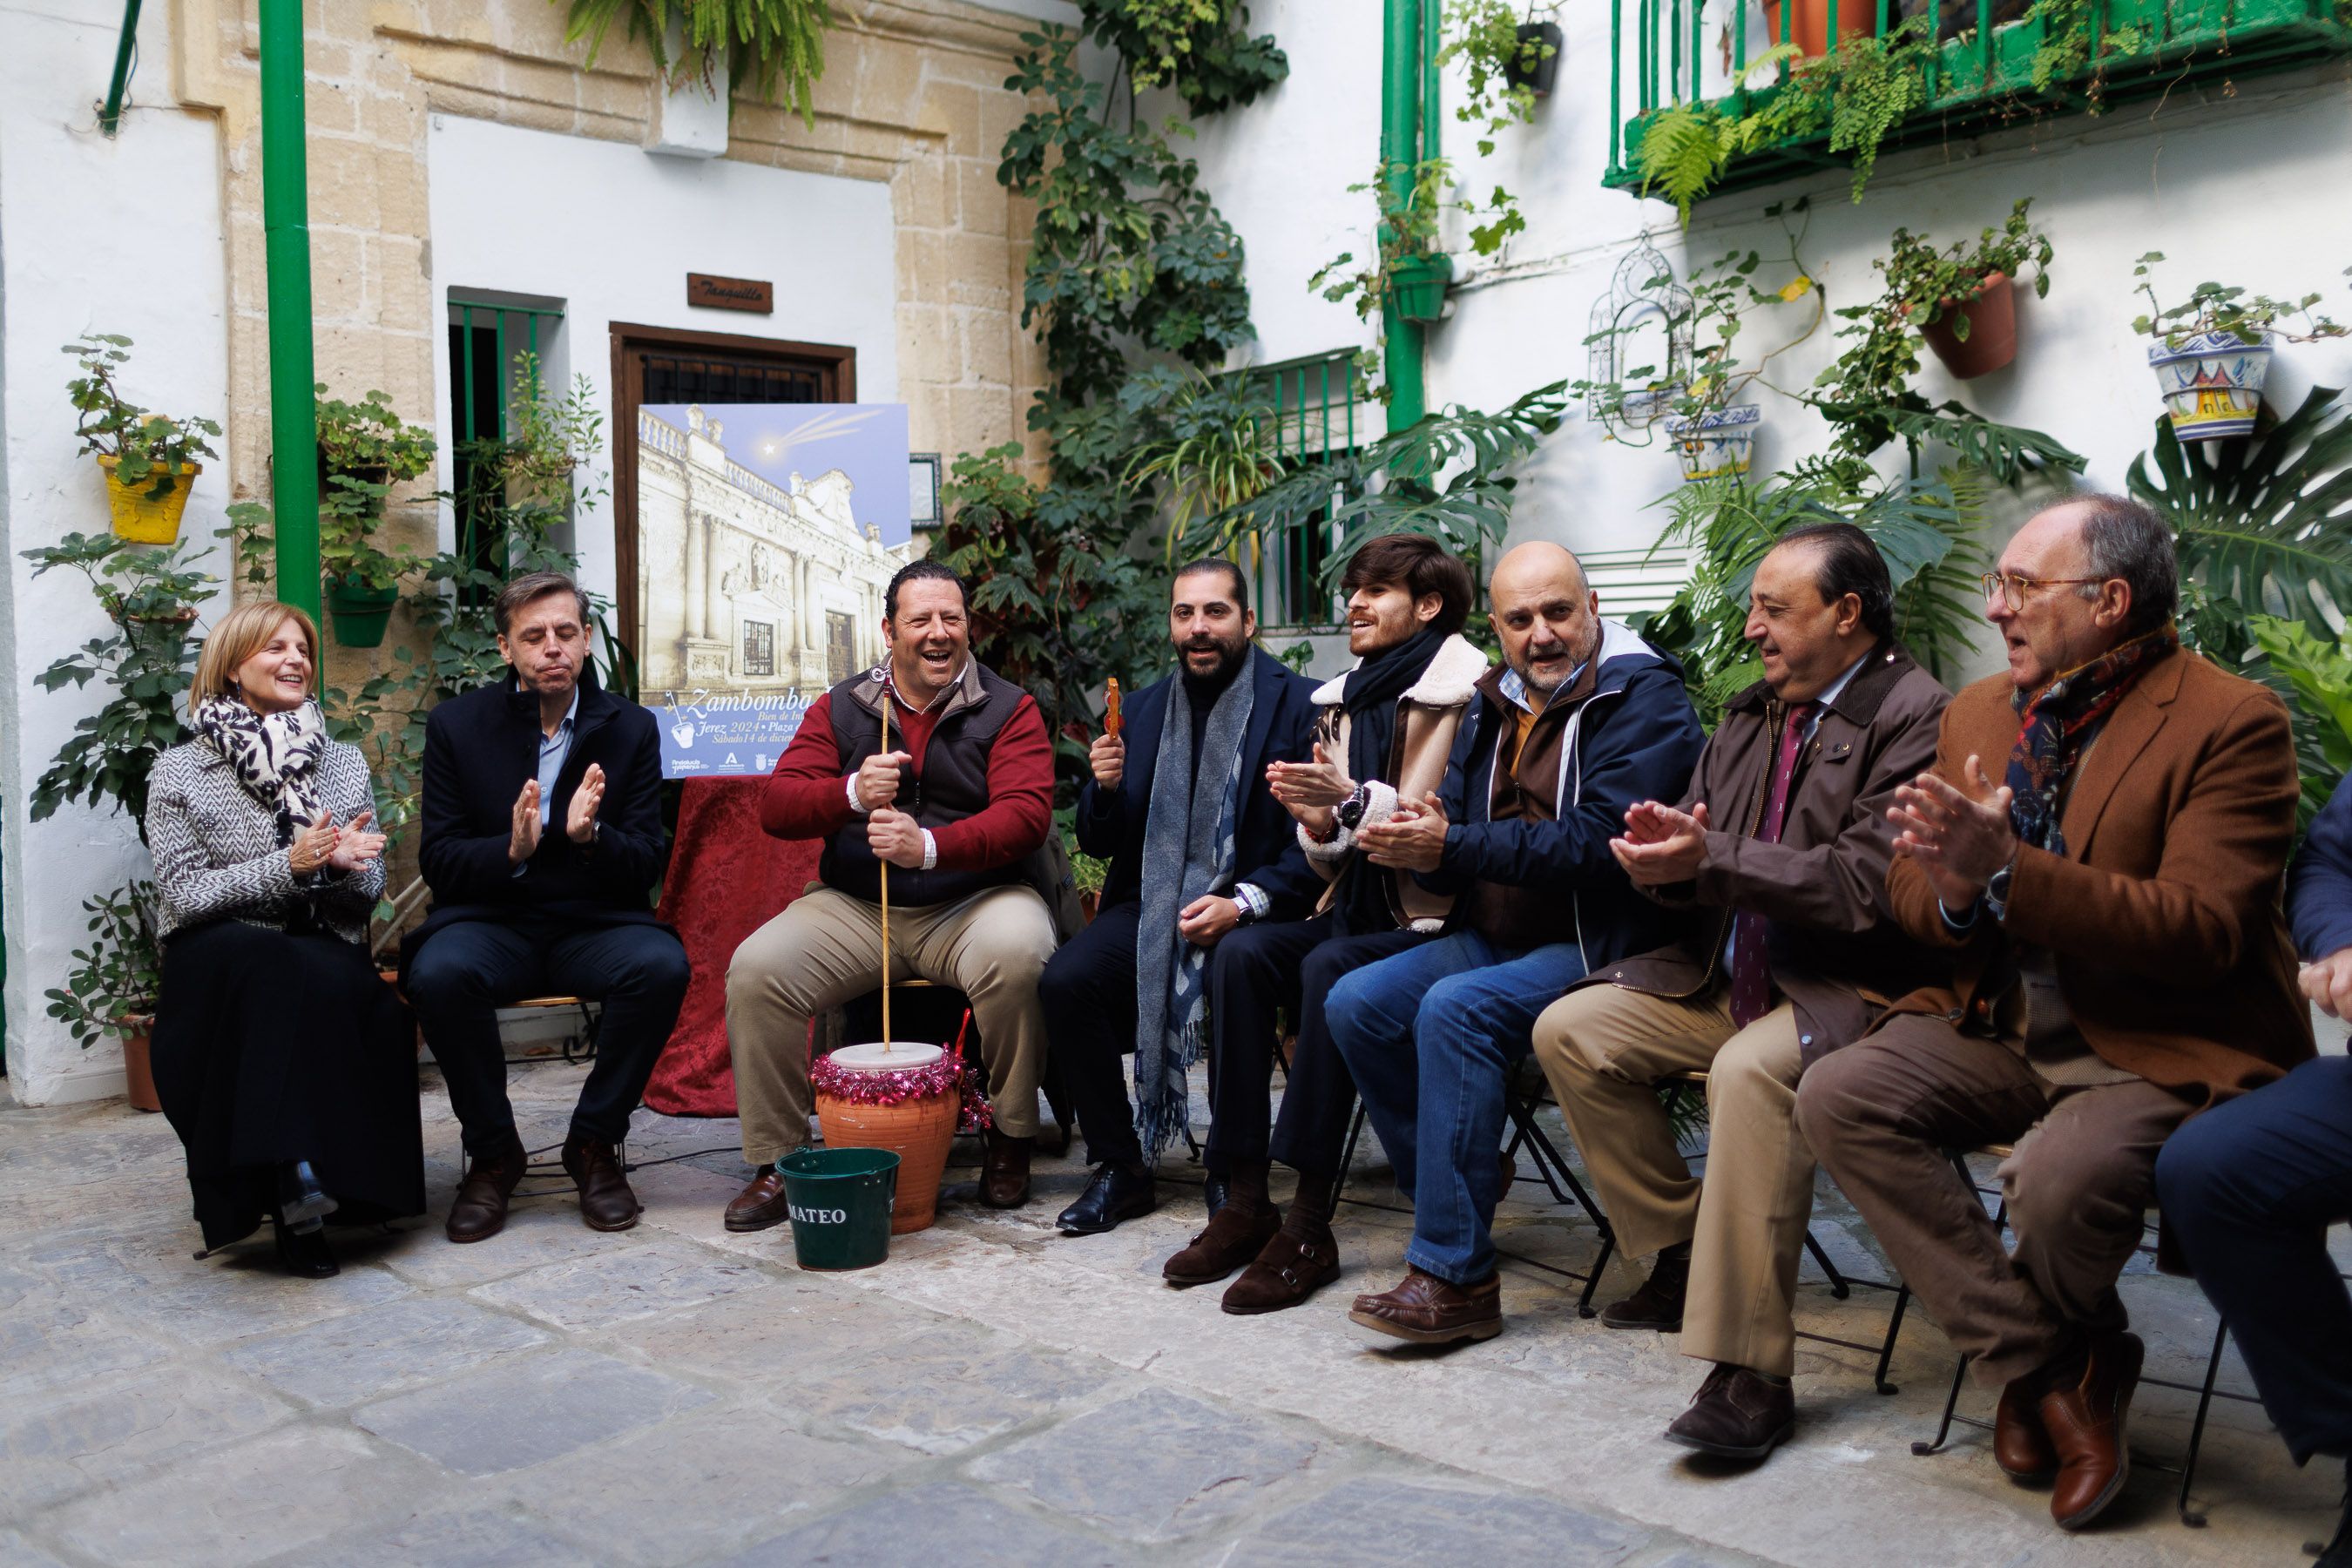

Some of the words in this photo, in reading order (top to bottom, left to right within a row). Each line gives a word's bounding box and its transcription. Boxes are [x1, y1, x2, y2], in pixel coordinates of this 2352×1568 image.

[687, 686, 812, 720] Zambomba
[758, 711, 777, 721] Bien
[780, 711, 788, 721] de
[696, 721, 727, 737] Jerez
[731, 721, 760, 733] 2024
[768, 721, 794, 733] Plaza
[757, 733, 767, 743] de
[787, 1203, 847, 1224] MATEO
